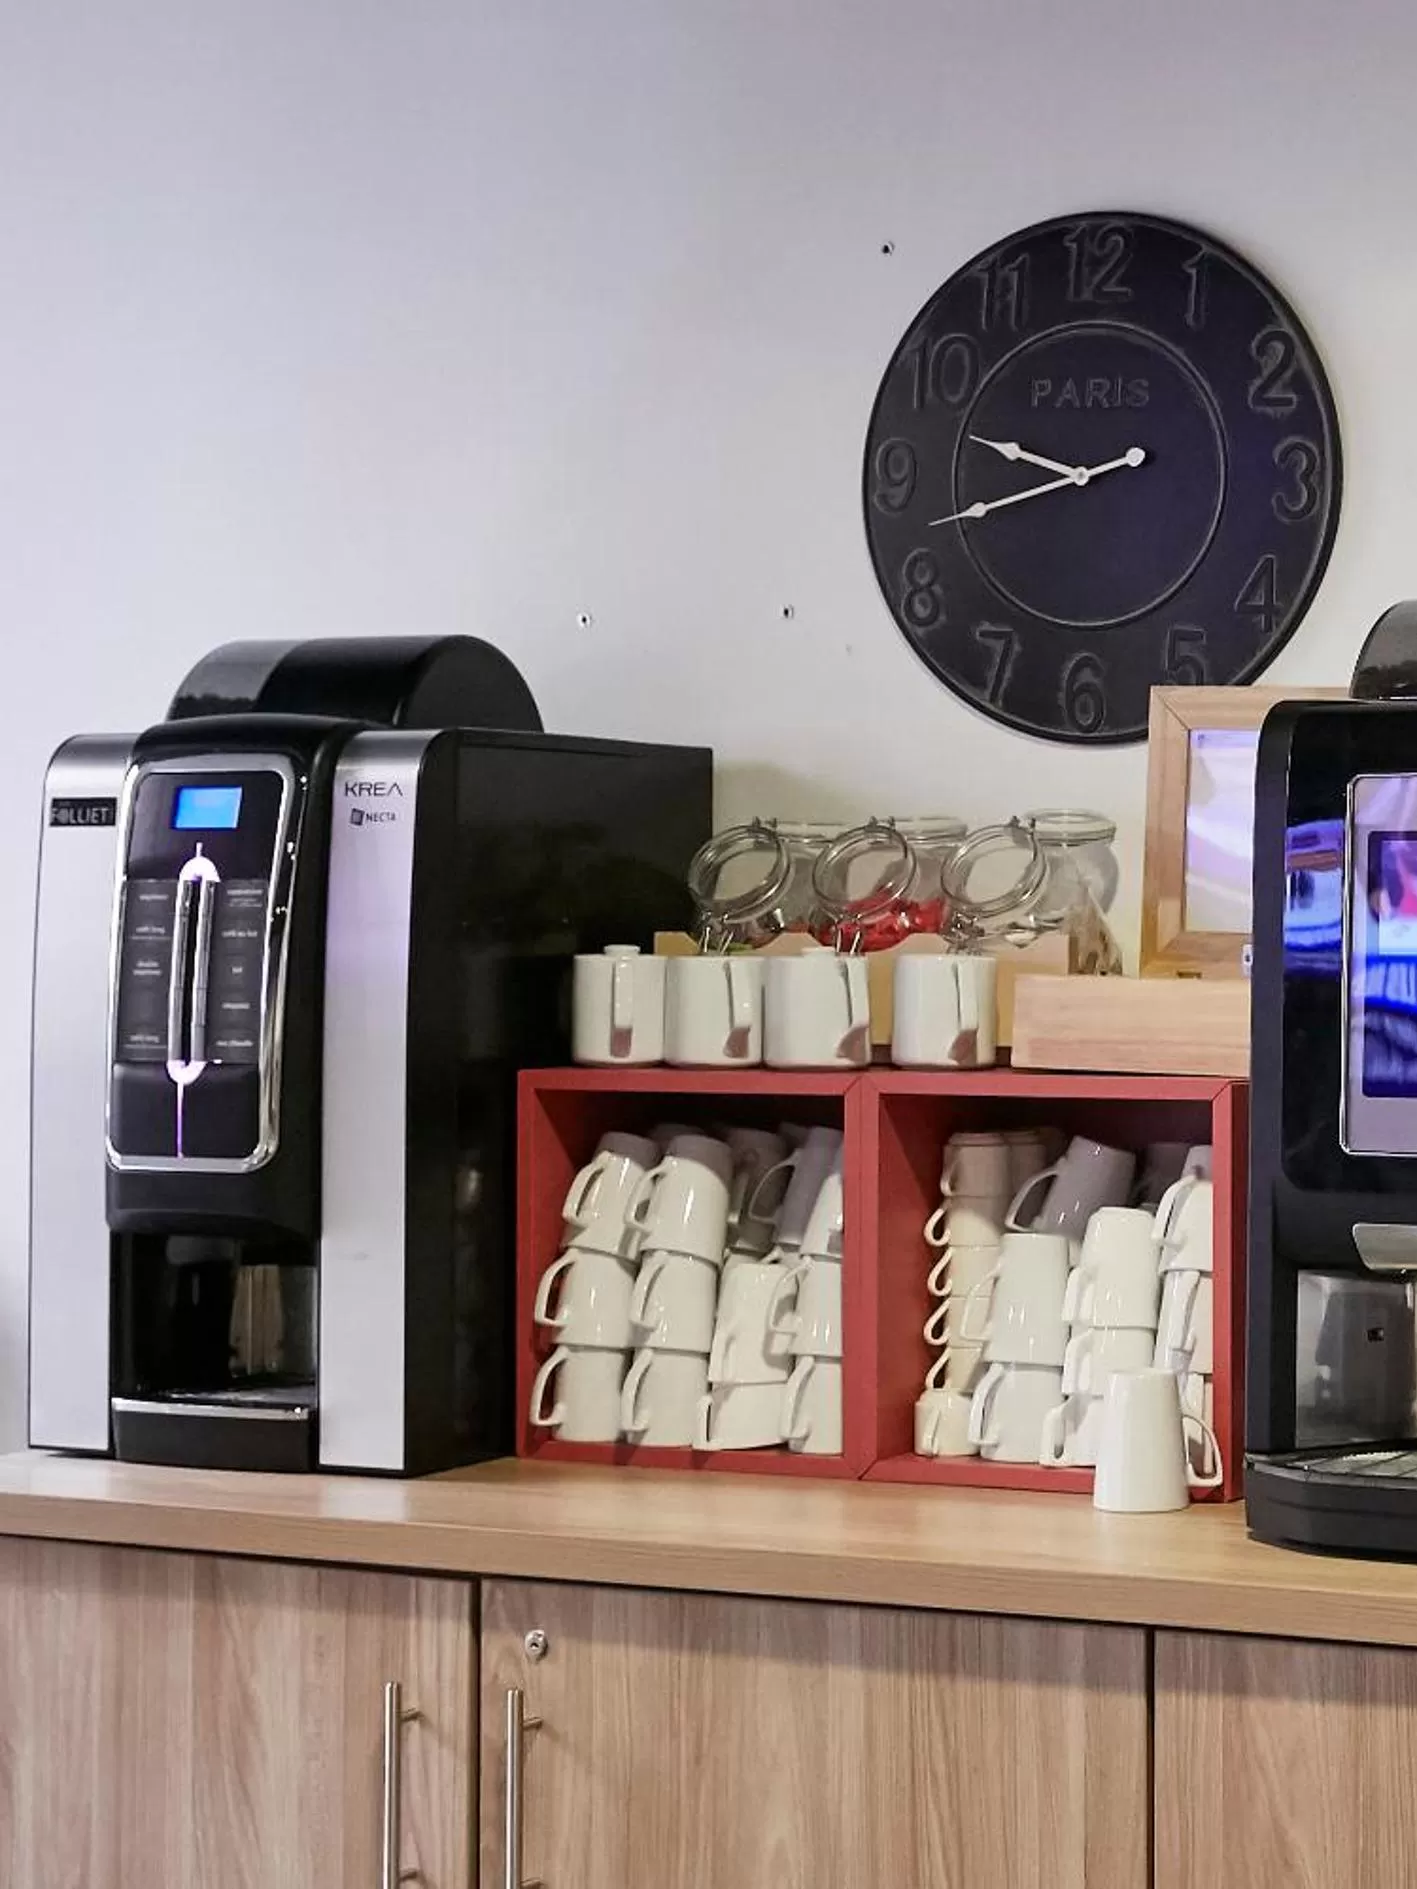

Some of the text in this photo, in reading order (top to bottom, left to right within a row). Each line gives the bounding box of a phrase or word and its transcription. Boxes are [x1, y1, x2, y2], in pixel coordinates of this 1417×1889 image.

[974, 252, 1030, 332] 11
[1063, 225, 1133, 302] 12
[1181, 249, 1210, 330] 1
[904, 332, 981, 409] 10
[1031, 377, 1150, 409] PARIS
[1248, 328, 1298, 414] 2
[873, 437, 919, 516] 9
[1271, 436, 1320, 523] 3
[902, 548, 945, 629] 8
[1235, 552, 1285, 634] 4
[975, 624, 1021, 705] 7
[1060, 651, 1106, 735] 6
[344, 781, 403, 798] KREA
